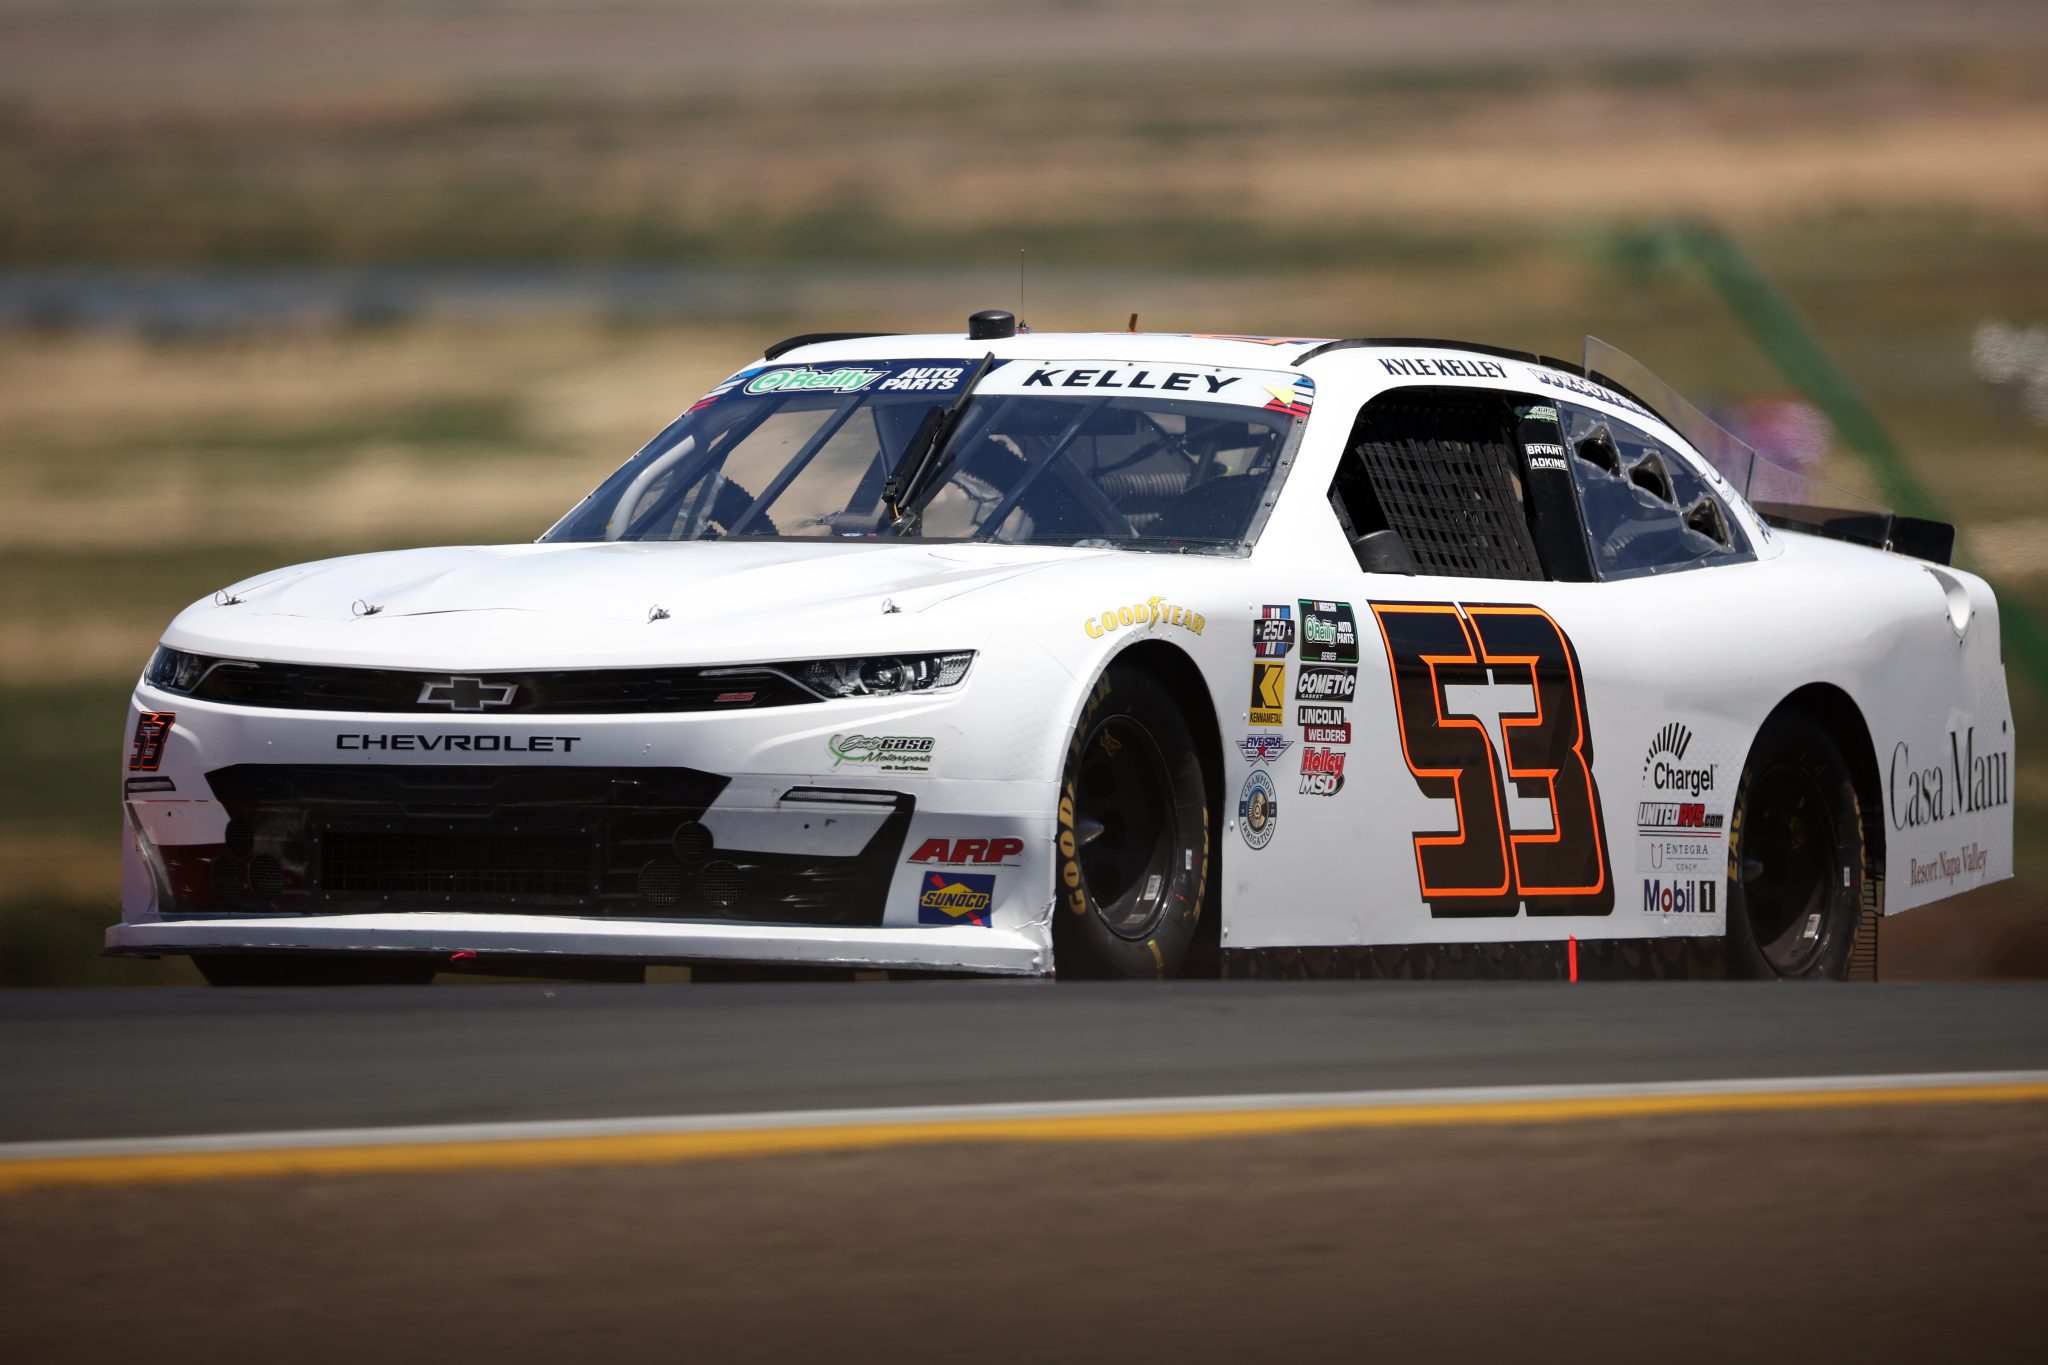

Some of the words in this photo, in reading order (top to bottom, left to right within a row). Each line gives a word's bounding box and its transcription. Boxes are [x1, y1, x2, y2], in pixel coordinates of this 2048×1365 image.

[896, 367, 964, 379] AUTO
[1377, 358, 1436, 376] KYLE
[1431, 359, 1508, 379] KELLEY
[744, 367, 891, 396] O'Reilly
[878, 378, 959, 390] PARTS
[1022, 369, 1242, 393] KELLEY
[1527, 445, 1563, 457] BRYANT
[1531, 457, 1566, 469] ADKINS
[1263, 620, 1286, 641] 250
[1337, 621, 1352, 633] AUTO
[1336, 632, 1355, 645] PARTS
[1321, 651, 1337, 661] SERIES
[1298, 672, 1355, 695] COMETIC
[1249, 711, 1283, 724] KENNAMETAL
[1299, 708, 1342, 725] LINCOLN
[129, 711, 177, 771] 53
[336, 733, 582, 753] CHEVROLET
[1246, 736, 1264, 749] FIVE
[1264, 736, 1282, 749] STAR
[1308, 728, 1347, 742] WELDERS
[1302, 746, 1346, 779] Holley
[1364, 598, 1616, 919] 53
[1243, 774, 1273, 798] CHAMPION
[1299, 774, 1340, 796] MSD
[1654, 761, 1714, 798] Chargel
[1889, 740, 1945, 831] Casa
[1949, 720, 2008, 817] Mani
[1241, 820, 1274, 846] IRRIGATION
[908, 838, 1024, 862] ARP
[1666, 843, 1709, 855] ENTEGRA
[1675, 863, 1698, 871] COACH
[1910, 857, 1938, 886] Resort
[1938, 850, 1961, 885] Napa
[1961, 842, 1988, 877] Valley
[923, 892, 986, 908] SUNOCO
[1643, 879, 1695, 913] Mobil
